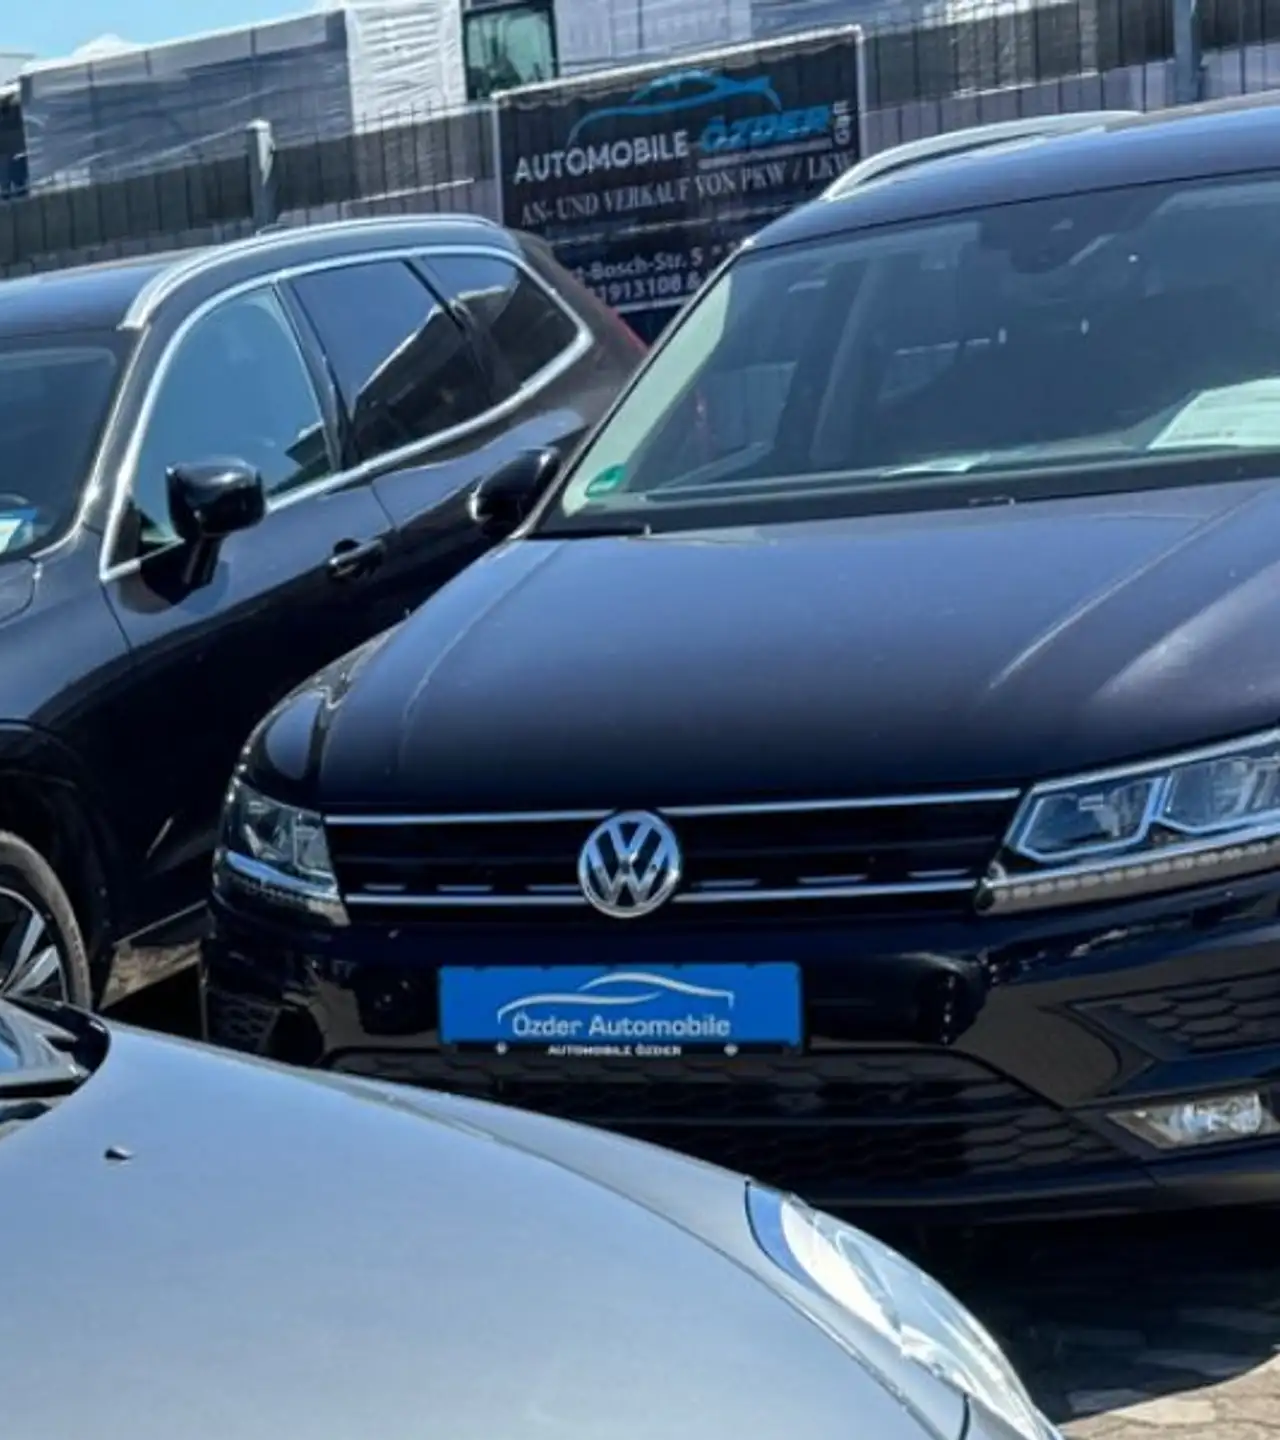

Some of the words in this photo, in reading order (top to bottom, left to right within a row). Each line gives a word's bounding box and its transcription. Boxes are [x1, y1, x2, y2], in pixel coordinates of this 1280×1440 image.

[513, 129, 690, 185] AUTOMOBILE
[603, 177, 690, 212] VERKAUF
[694, 170, 737, 197] VON
[741, 159, 788, 192] PKW
[808, 149, 856, 181] LKW
[512, 1012, 583, 1038] Özder
[589, 1014, 732, 1038] Automobile
